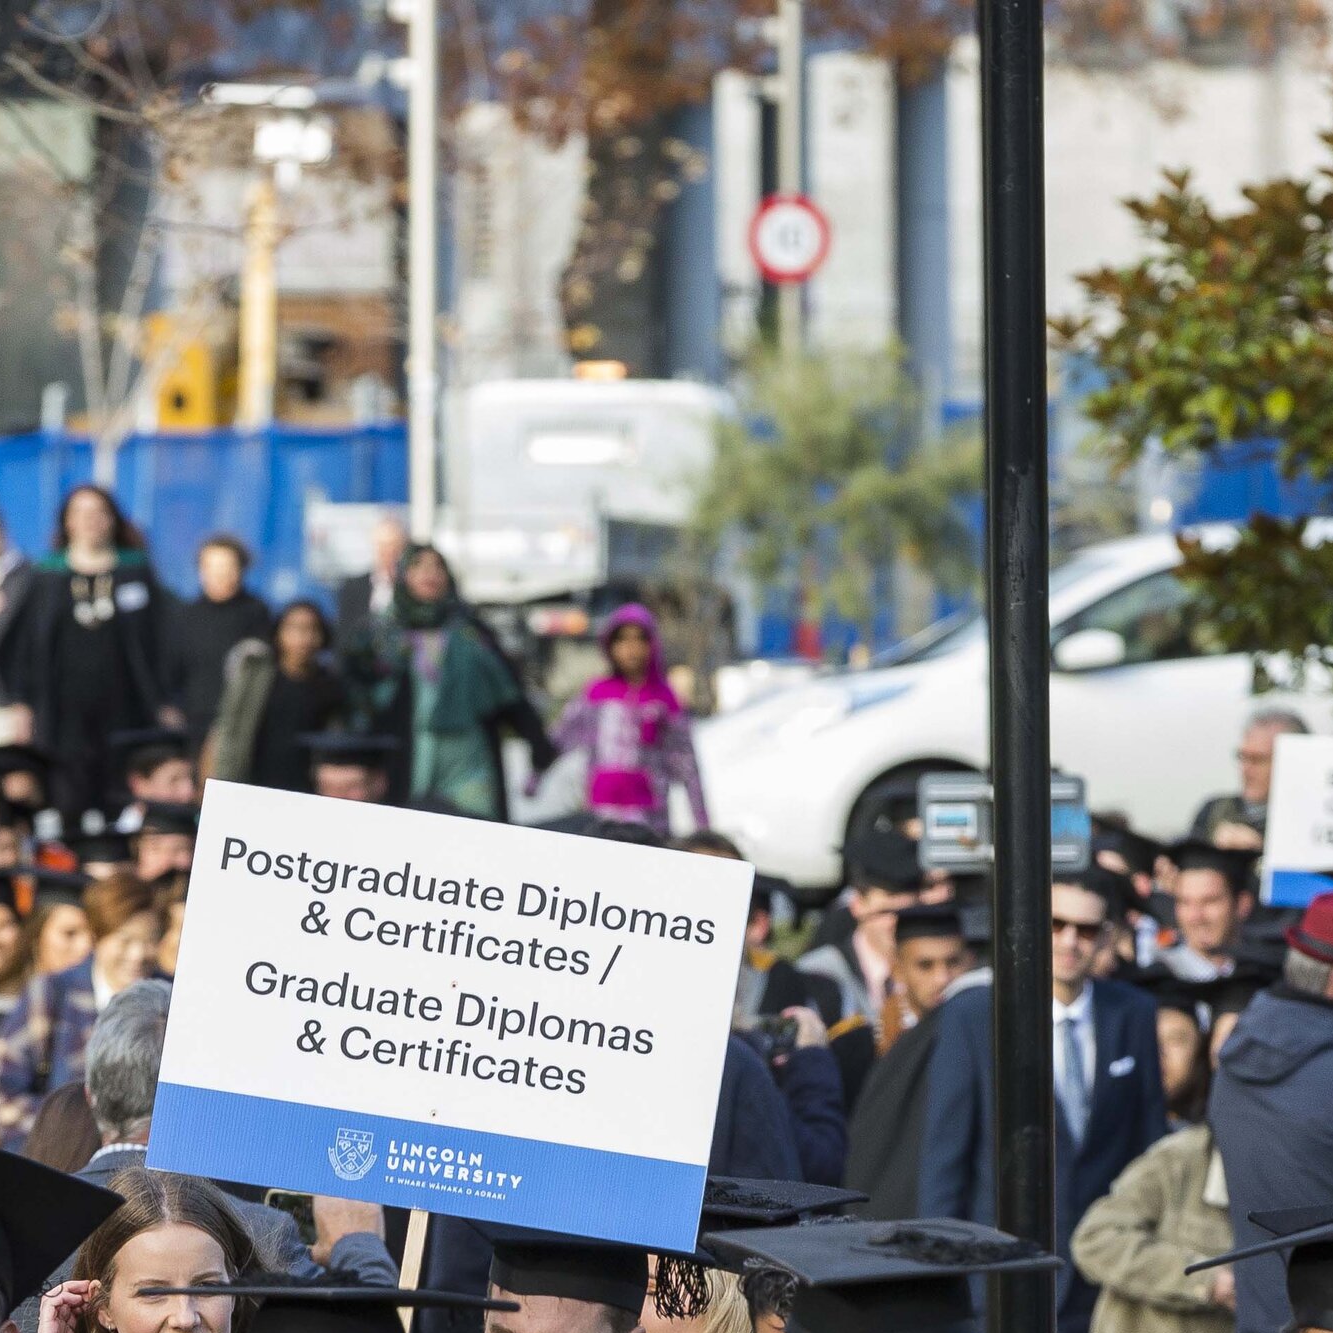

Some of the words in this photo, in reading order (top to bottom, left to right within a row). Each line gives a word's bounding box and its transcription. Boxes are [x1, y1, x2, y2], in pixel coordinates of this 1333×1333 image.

[220, 836, 505, 912] Postgraduate
[517, 882, 716, 945] Diplomas
[300, 900, 331, 936] &
[344, 907, 590, 976] Certificates
[598, 944, 623, 985] /
[245, 961, 443, 1022] Graduate
[455, 992, 654, 1055] Diplomas
[296, 1019, 327, 1055] &
[340, 1026, 586, 1095] Certificates
[385, 1175, 395, 1183] TE
[397, 1177, 426, 1188] WHARE
[466, 1188, 473, 1196] O
[474, 1190, 506, 1201] AORAKI
[386, 1155, 523, 1189] UNIVERSITY
[388, 1140, 483, 1167] LINCOLN
